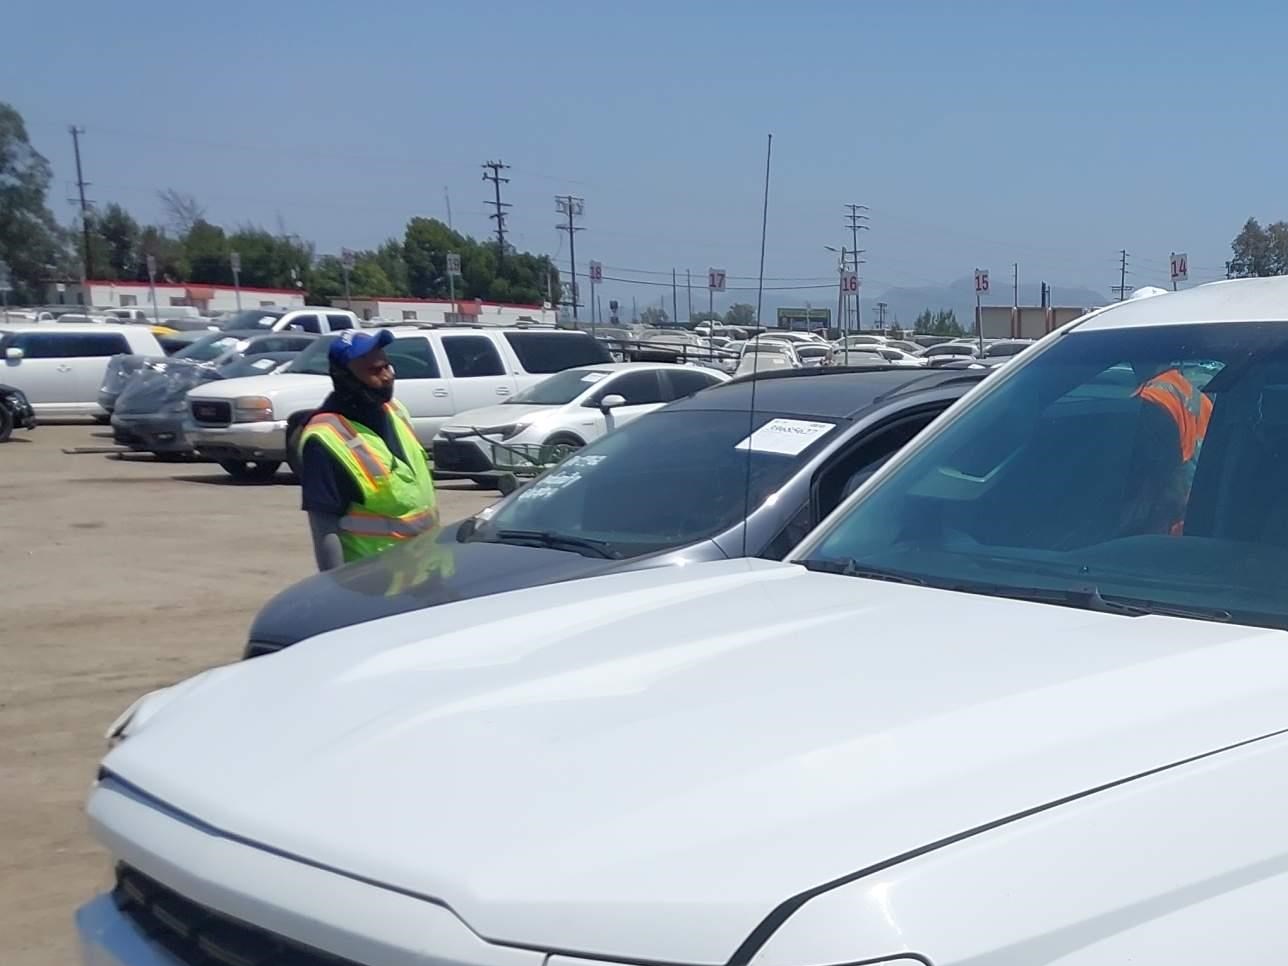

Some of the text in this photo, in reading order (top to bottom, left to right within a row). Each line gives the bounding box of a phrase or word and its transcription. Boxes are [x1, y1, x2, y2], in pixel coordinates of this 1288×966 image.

[1171, 258, 1187, 277] 14
[709, 273, 726, 288] 17
[842, 276, 858, 291] 16
[975, 275, 989, 291] 15
